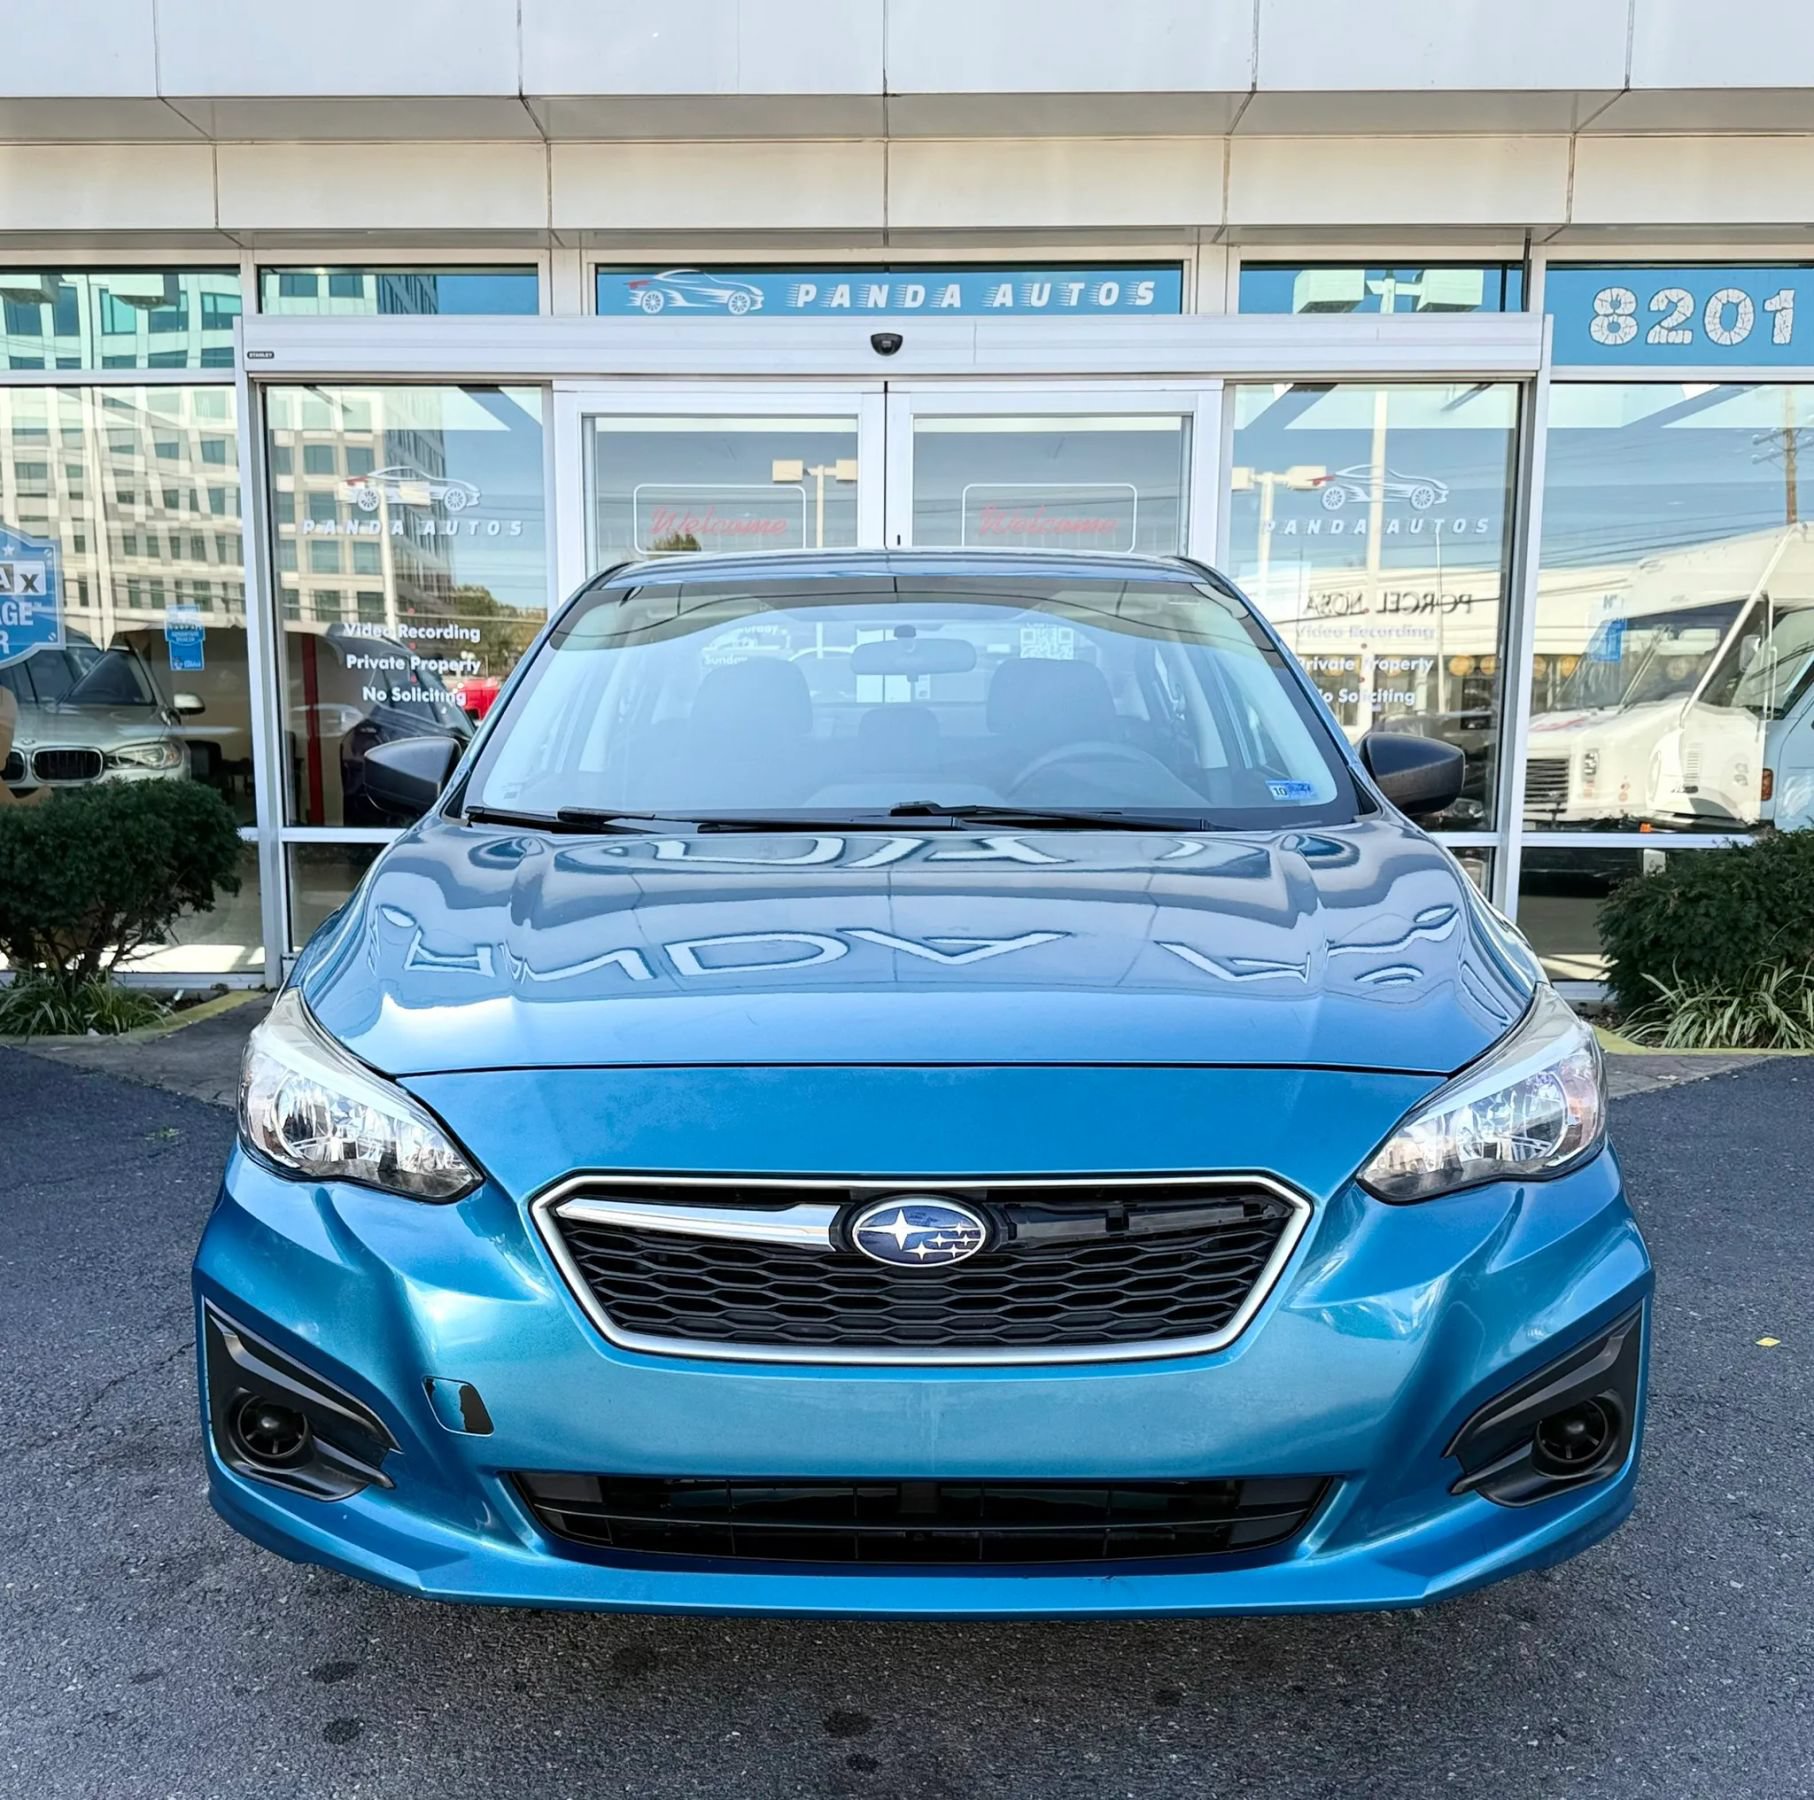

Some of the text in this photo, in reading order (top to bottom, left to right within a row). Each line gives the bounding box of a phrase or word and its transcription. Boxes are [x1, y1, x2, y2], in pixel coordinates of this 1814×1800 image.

[790, 281, 1155, 309] PANDA AUTOS
[1588, 286, 1796, 347] 8201
[302, 519, 523, 536] PANDA AUTOS
[648, 504, 788, 536] Welcome
[978, 503, 1119, 536] Welcome
[1263, 518, 1489, 536] PANDA AUTOS
[343, 623, 481, 643] Video Recording
[1349, 623, 1435, 641] Recording
[346, 654, 481, 675] Private Property
[1364, 656, 1434, 676] Property
[362, 686, 467, 706] No Soliciting
